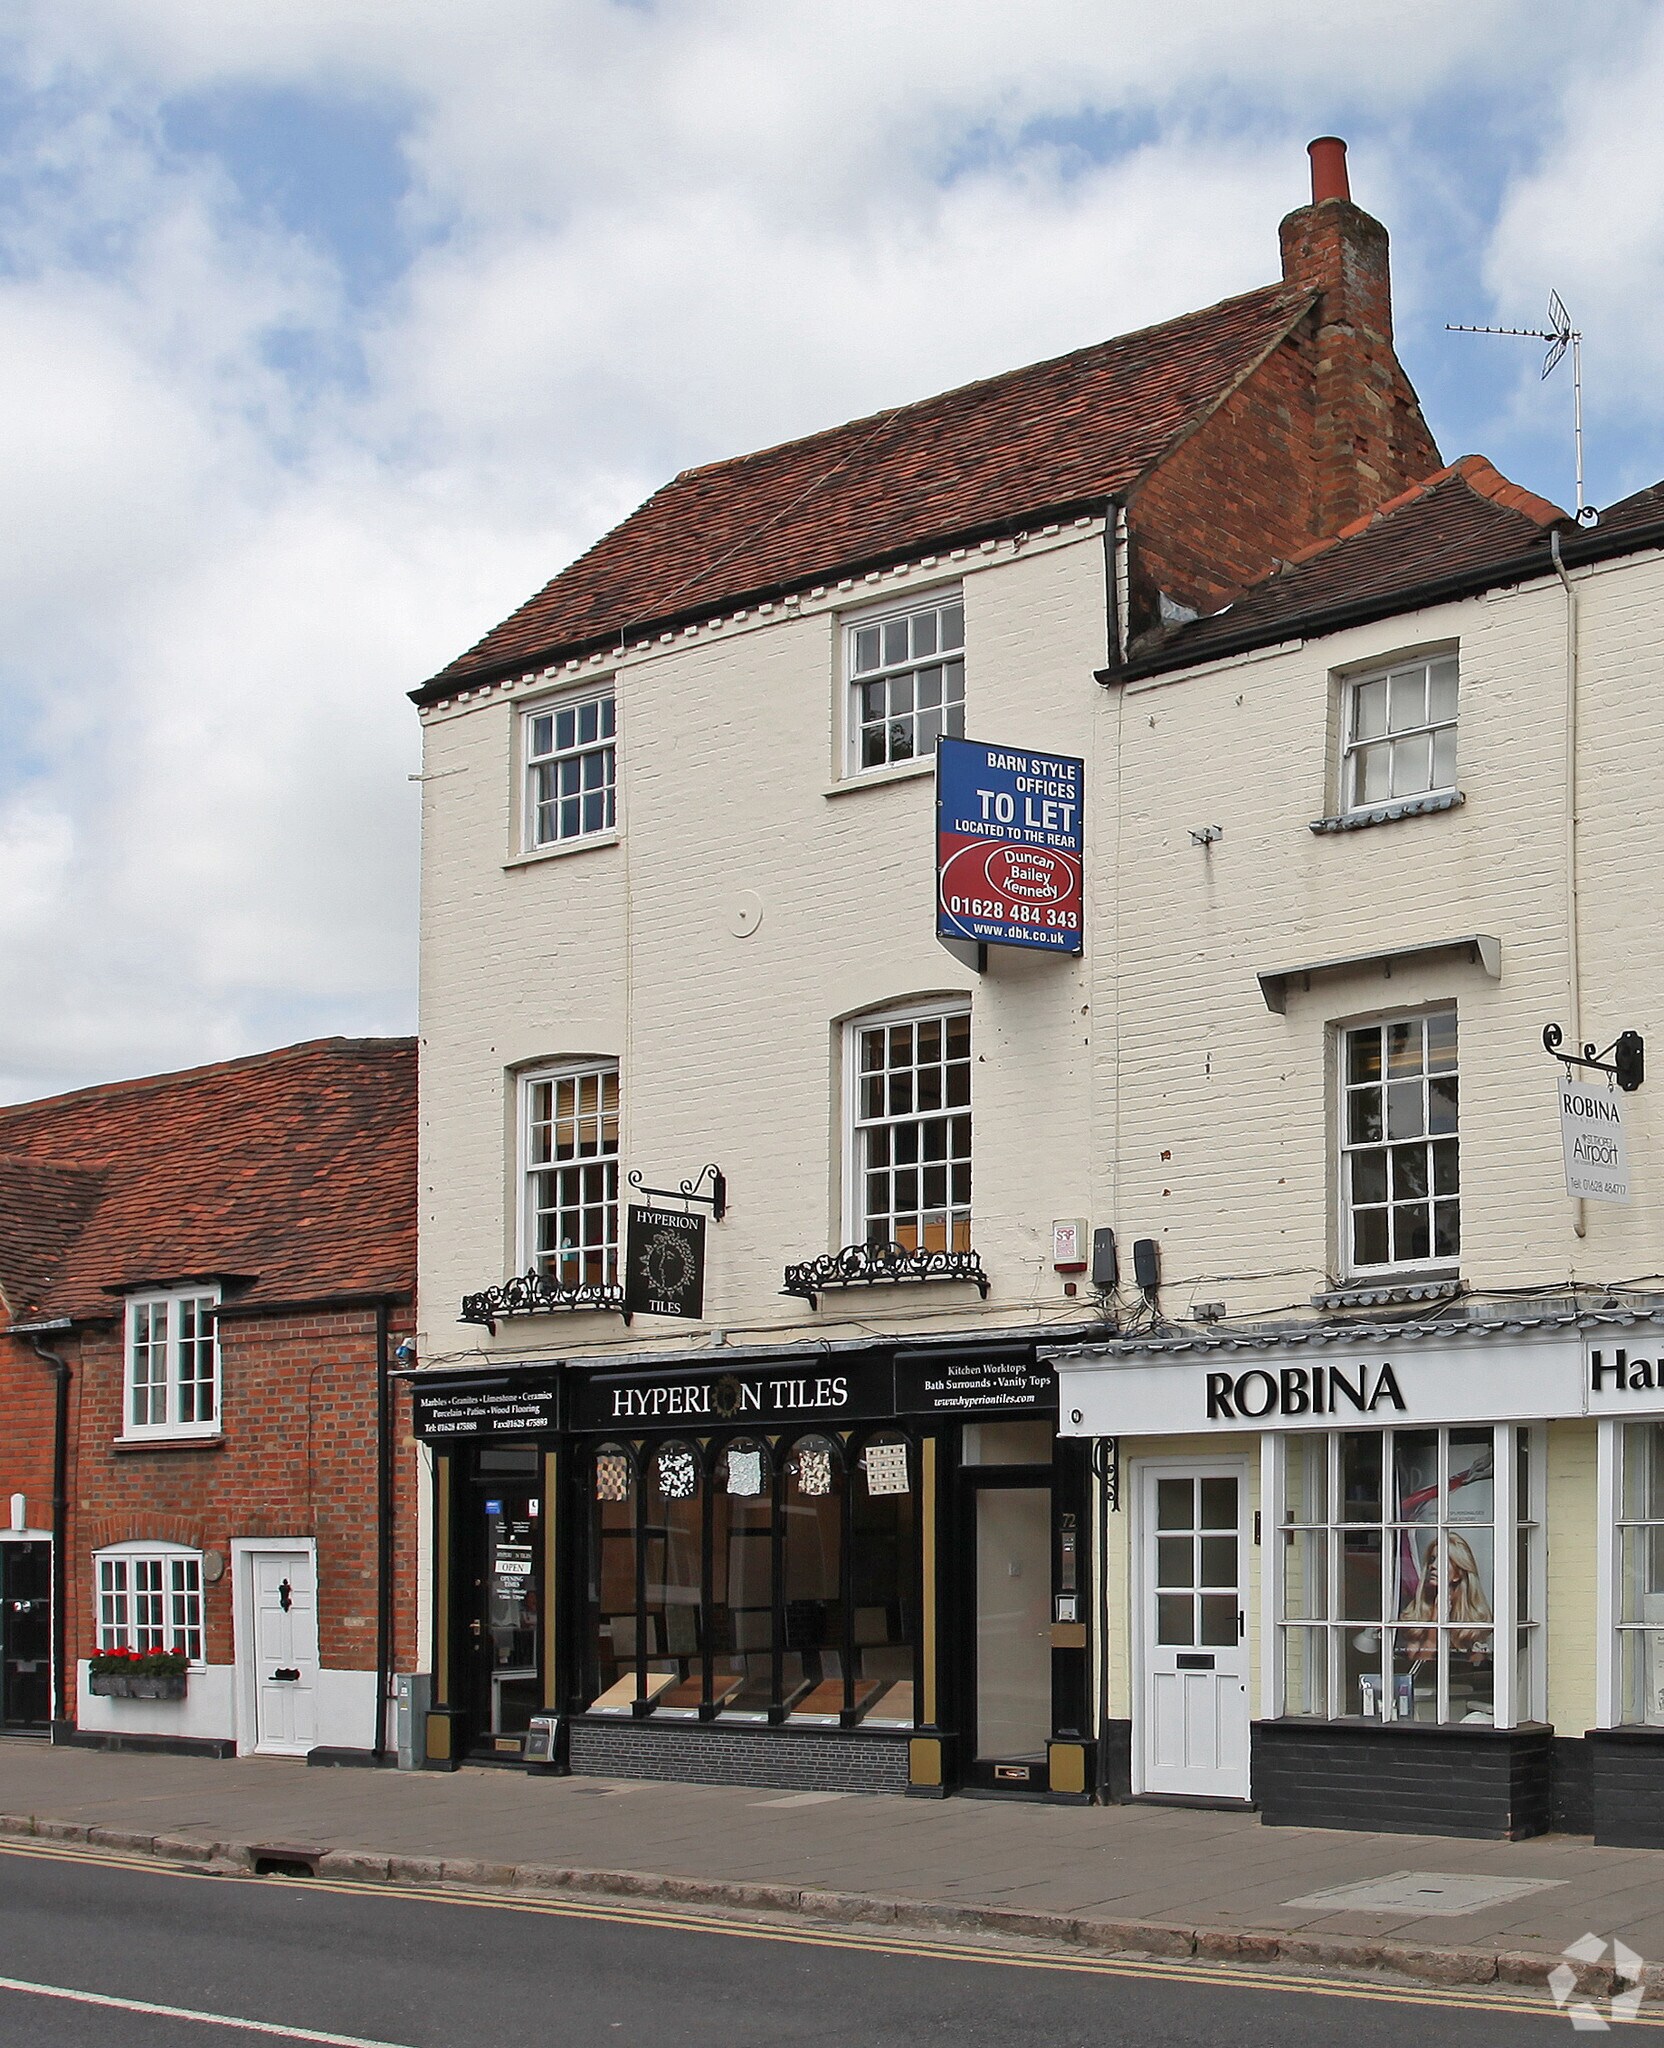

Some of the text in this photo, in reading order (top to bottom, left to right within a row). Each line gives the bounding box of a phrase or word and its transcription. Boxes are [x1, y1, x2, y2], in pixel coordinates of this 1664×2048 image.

[987, 752, 1076, 780] BARN STYLE
[1016, 776, 1075, 799] OFFICES
[977, 790, 1076, 832] TO LET
[955, 819, 1076, 848] LOCATED TO THE REAR
[1004, 851, 1055, 870] Duncan
[1011, 866, 1052, 886] Bailey
[1003, 877, 1058, 899] Kennedy
[950, 896, 1077, 929] 01628 484 343
[973, 923, 1065, 945] www.dbk.co.uk
[1563, 1094, 1620, 1123] ROBINA
[1573, 1138, 1618, 1165] Airport
[636, 1211, 699, 1230] HYPERION
[649, 1300, 681, 1314] TILES
[948, 1364, 1027, 1376] Kitchen Worktops
[769, 1377, 848, 1409] TILES
[925, 1376, 1051, 1390] Bath Surrounds Vanity Tops
[1206, 1362, 1406, 1419] ROBINA
[421, 1391, 553, 1407] Marbles Granites Limestone Ceramics
[934, 1394, 1035, 1408] www.hyperiontiles.com
[433, 1404, 540, 1418] Porcelain Patios Wood Flooring
[437, 1423, 455, 1432] 01628
[1062, 1513, 1076, 1527] 72
[502, 1563, 524, 1572] OPEN
